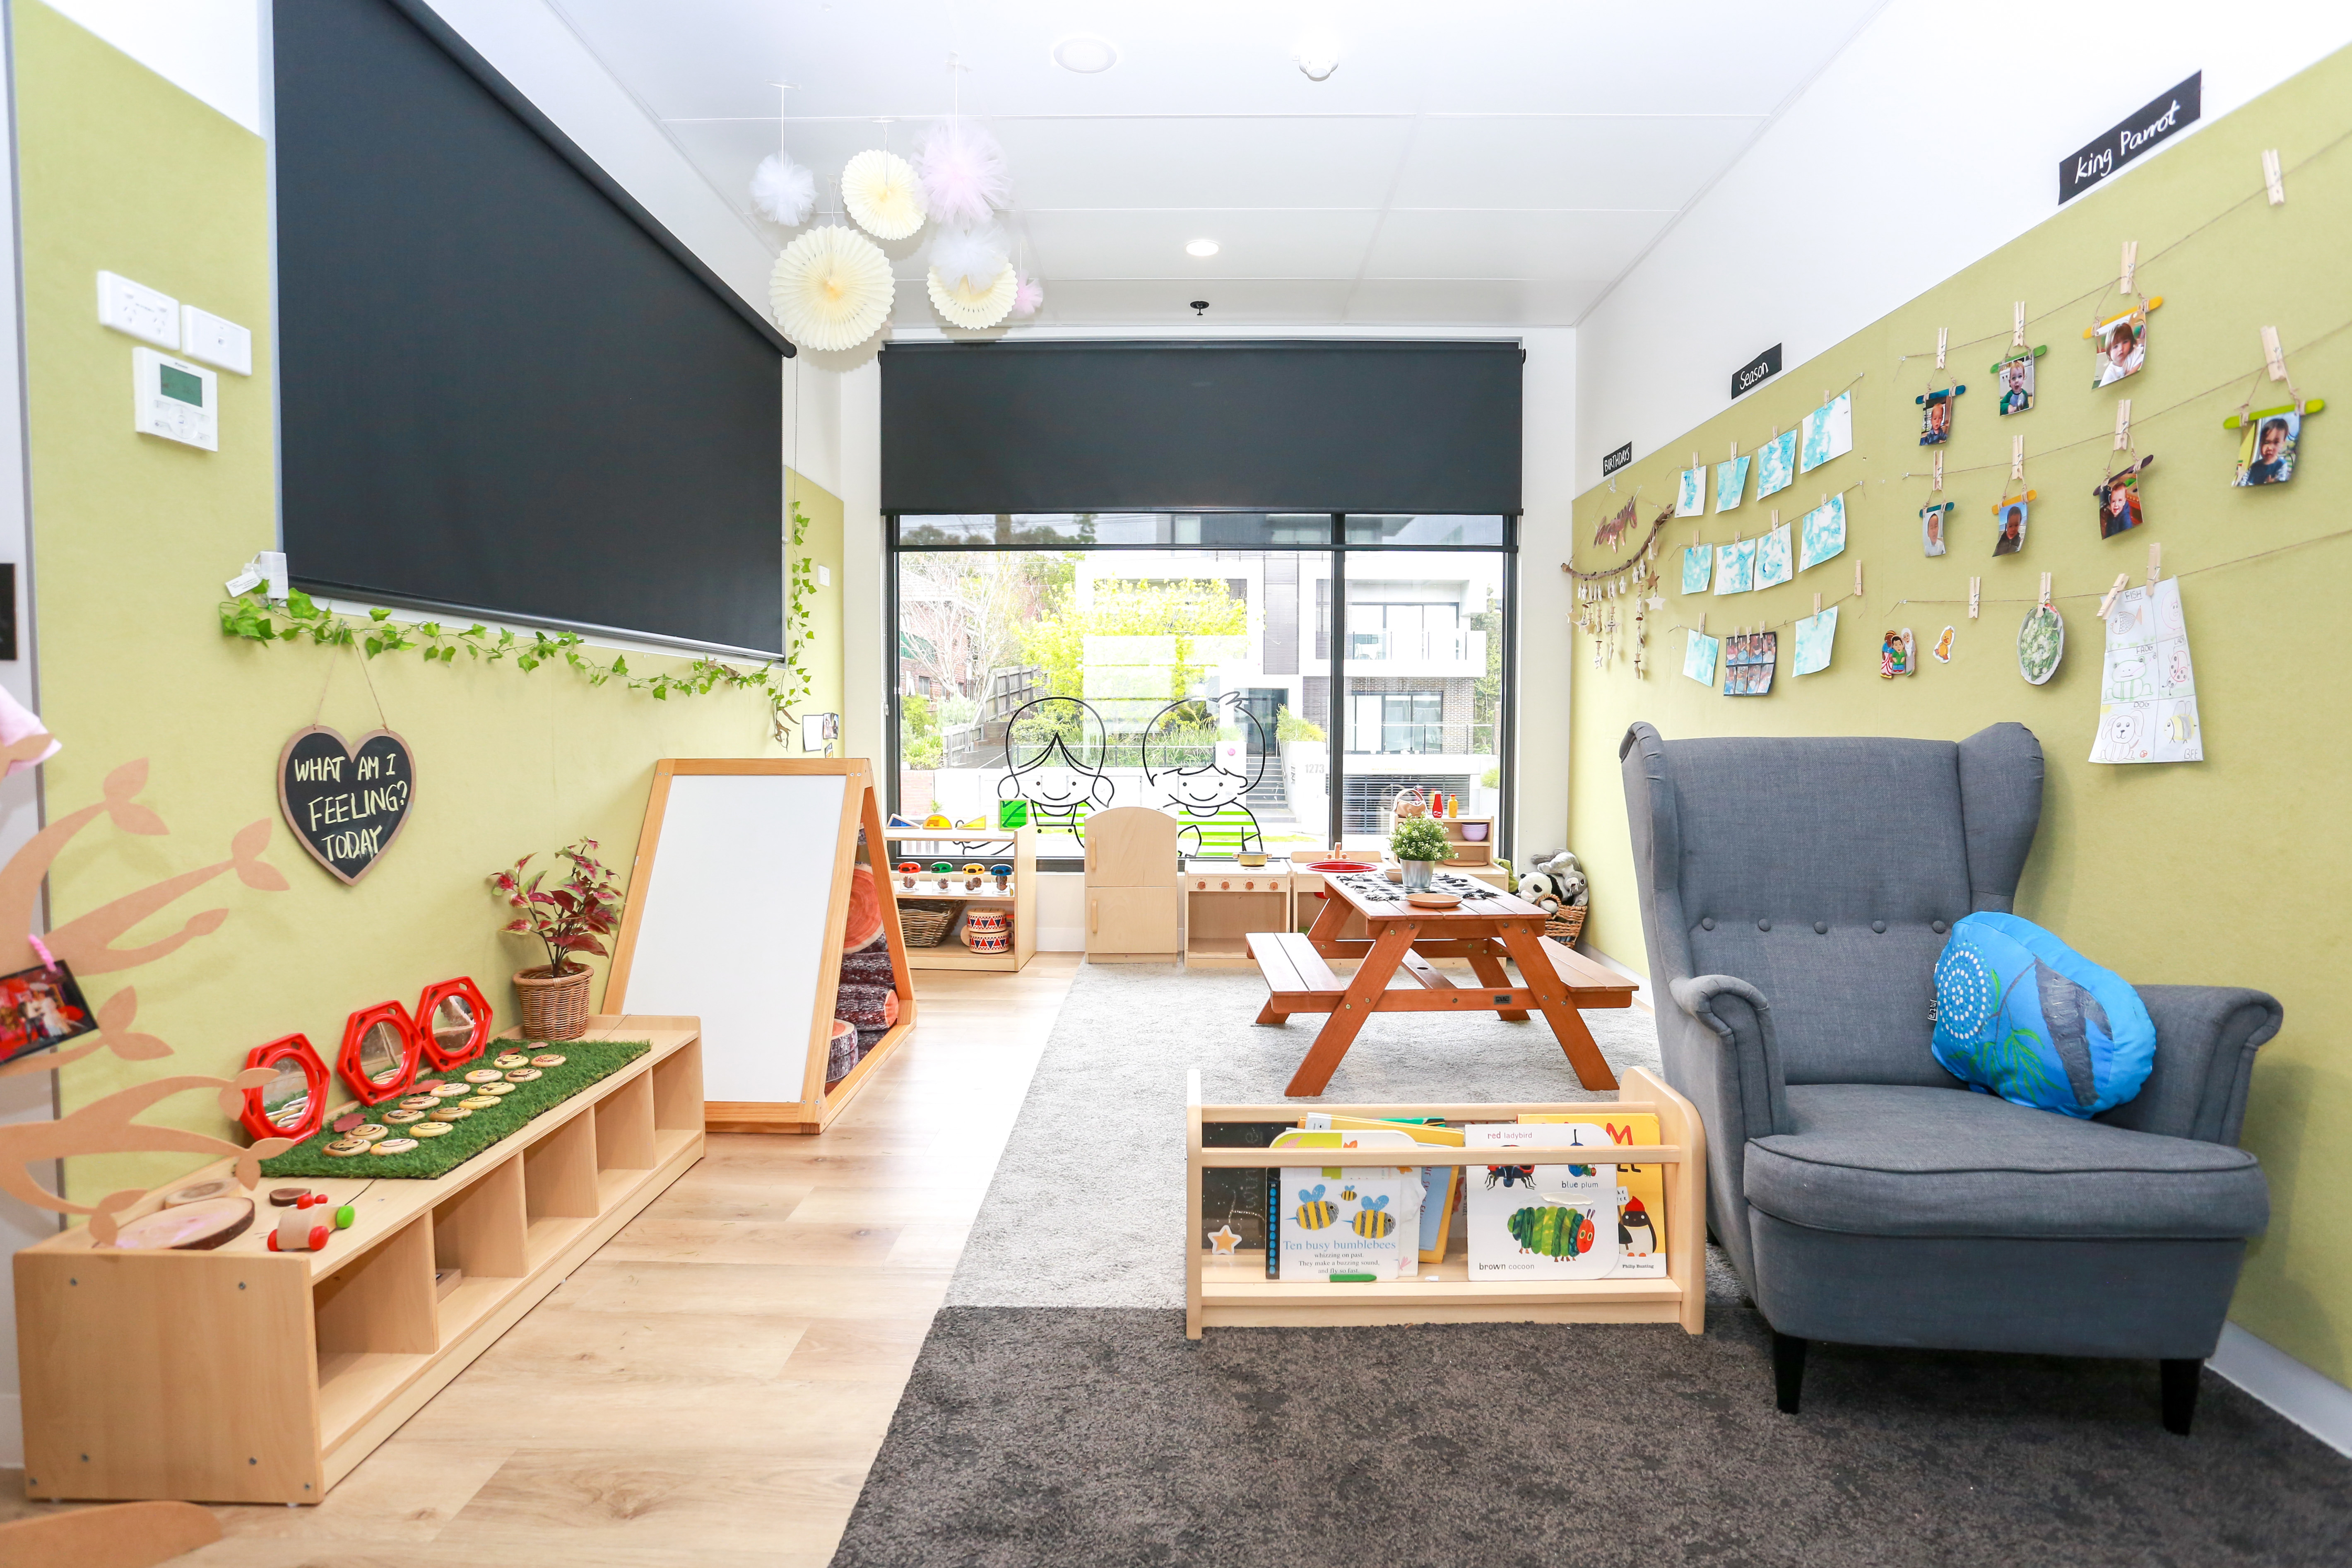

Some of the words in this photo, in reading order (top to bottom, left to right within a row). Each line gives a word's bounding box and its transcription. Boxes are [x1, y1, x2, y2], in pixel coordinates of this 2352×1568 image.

[2120, 99, 2181, 156] Parrot
[1740, 362, 1769, 390] Season
[1604, 447, 1630, 472] BIRTHDAYS
[2124, 590, 2142, 600] FISH
[2136, 645, 2153, 654] FROG
[2184, 748, 2198, 759] BEE
[295, 756, 346, 783] WHAT
[357, 756, 379, 781] AM
[386, 753, 397, 776] I
[1305, 764, 1324, 773] 1273
[308, 780, 407, 832] FEELING?
[321, 825, 383, 862] TODAY
[1283, 1241, 1302, 1250] Ten
[1306, 1240, 1330, 1251] busy
[1334, 1240, 1396, 1249] bumblebees
